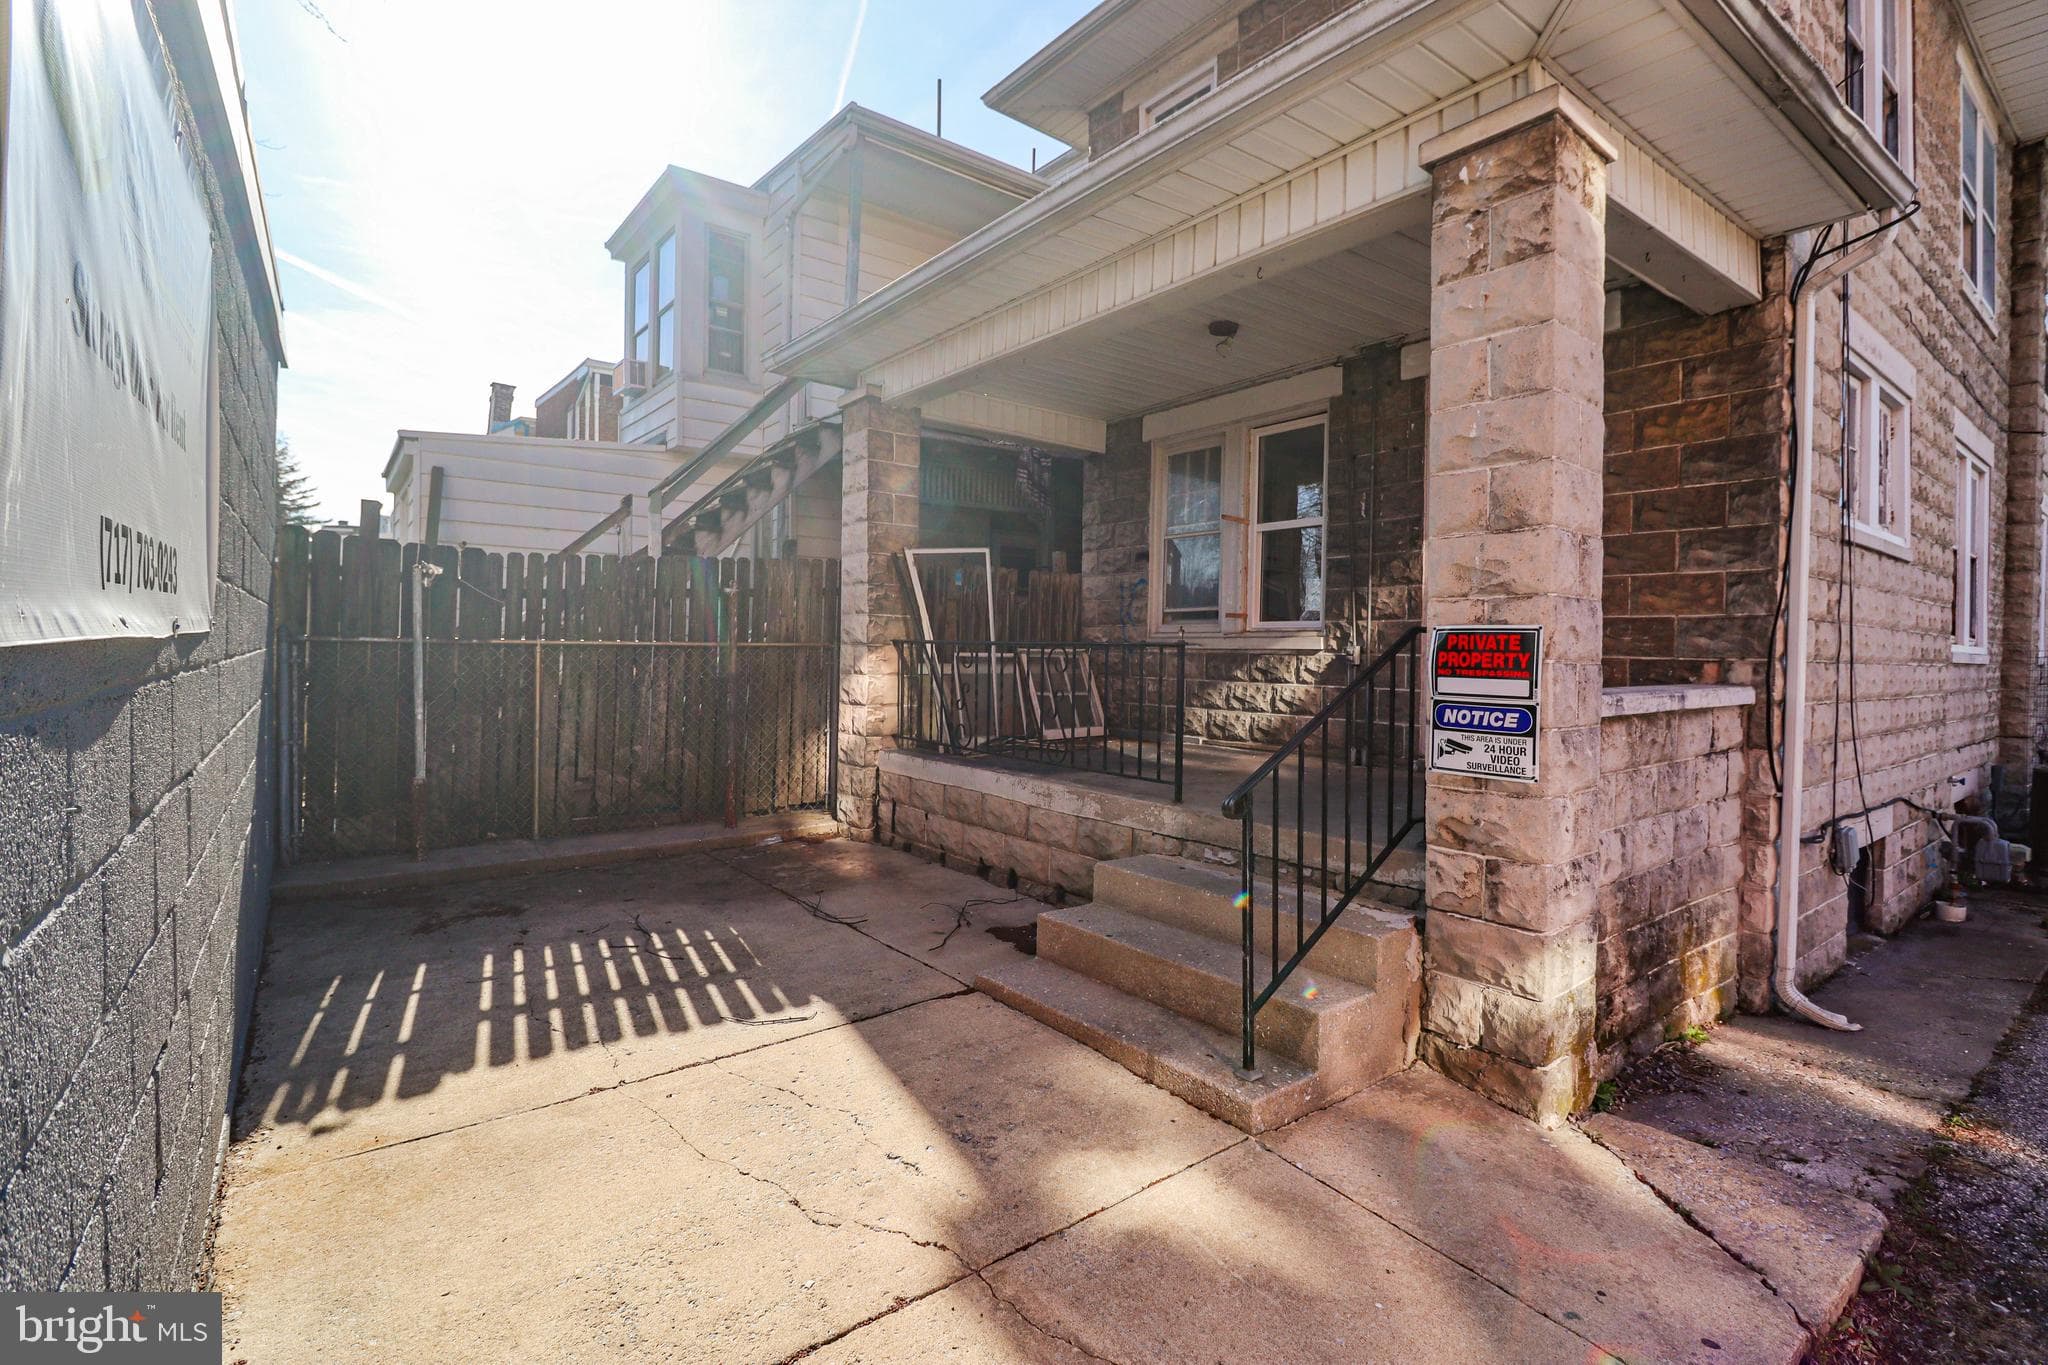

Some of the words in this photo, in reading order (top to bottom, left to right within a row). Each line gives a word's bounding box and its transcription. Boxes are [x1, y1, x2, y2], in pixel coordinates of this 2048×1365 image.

[100, 514, 133, 594] (717)
[136, 530, 178, 595] 703-0243
[1447, 634, 1521, 650] PRIVATE
[1438, 652, 1530, 669] PROPERTY
[1443, 708, 1520, 728] NOTICE
[1476, 735, 1493, 743] AREA
[1503, 738, 1527, 746] UNDER
[1484, 744, 1496, 754] 24
[1499, 745, 1526, 757] HOUR
[1466, 761, 1527, 775] SURVEILLANCE
[1490, 755, 1520, 767] VIDEO
